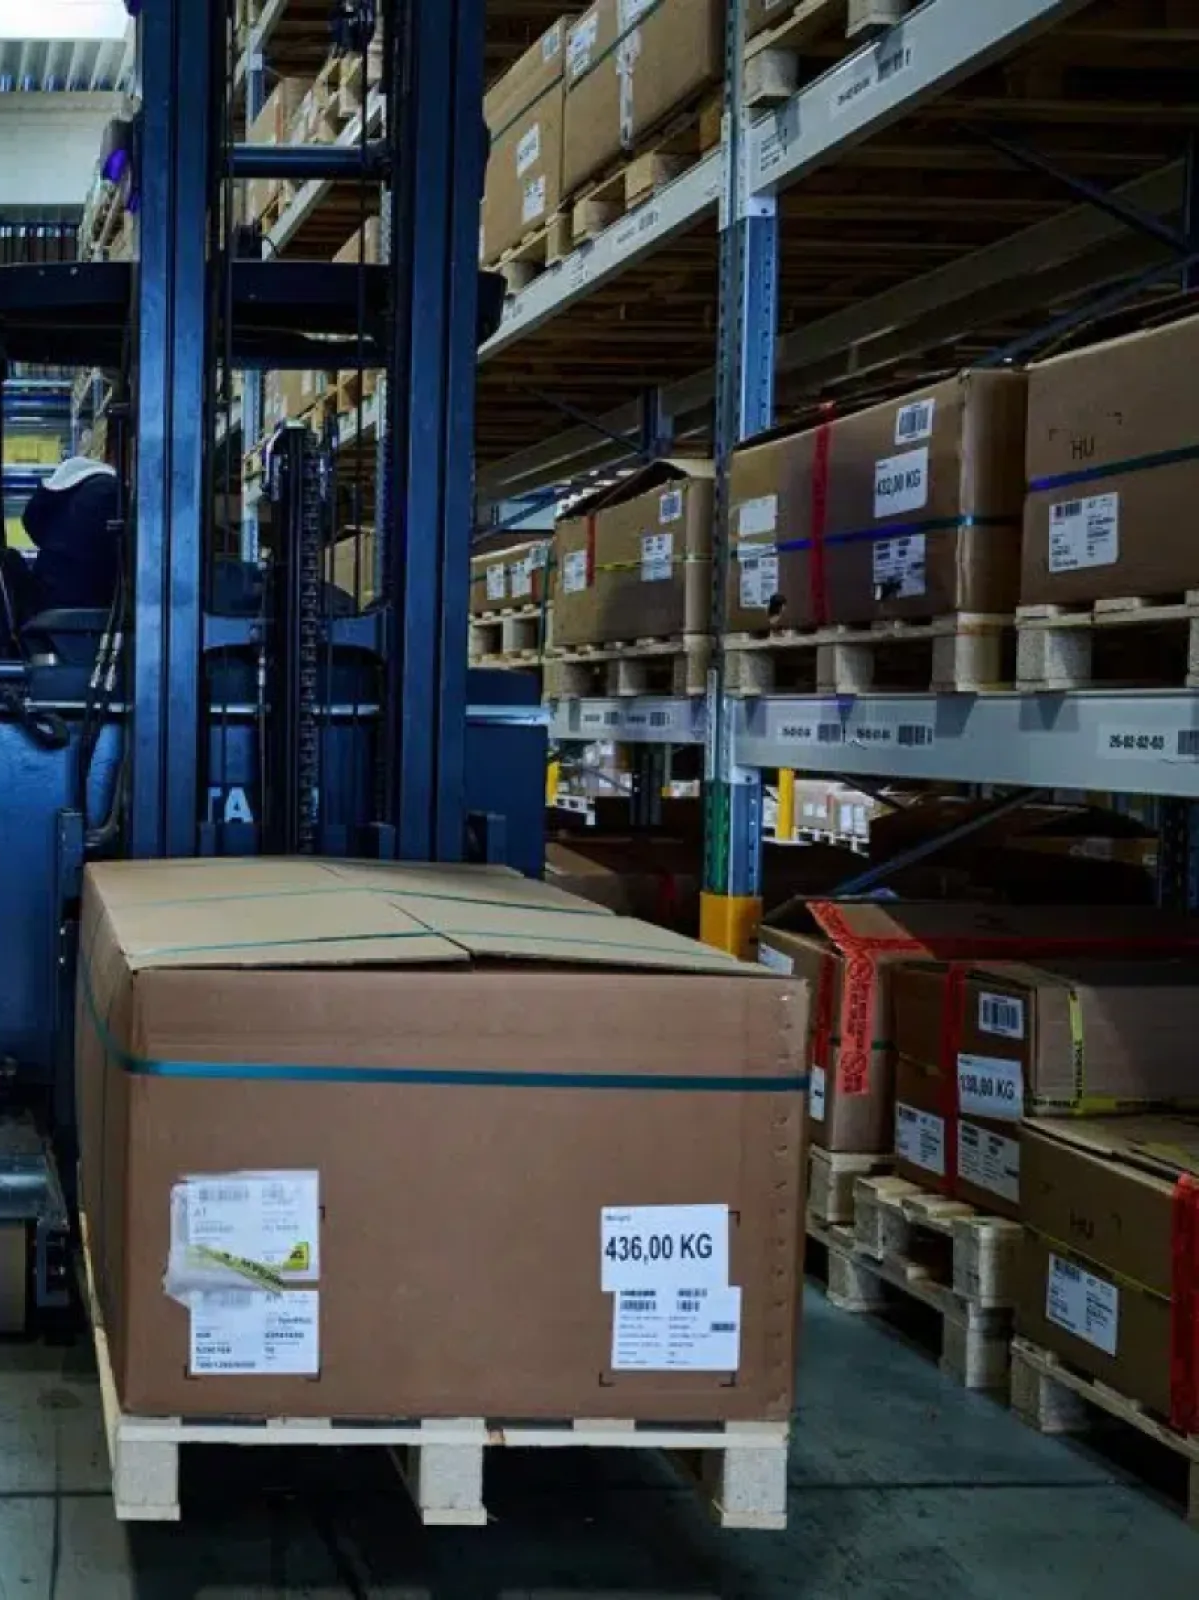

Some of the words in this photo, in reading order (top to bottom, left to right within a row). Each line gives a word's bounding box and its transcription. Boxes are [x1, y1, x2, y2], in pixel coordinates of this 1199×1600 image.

[906, 468, 921, 488] KG
[996, 1079, 1016, 1101] KG
[605, 1234, 673, 1264] 436,00
[680, 1233, 713, 1260] KG
